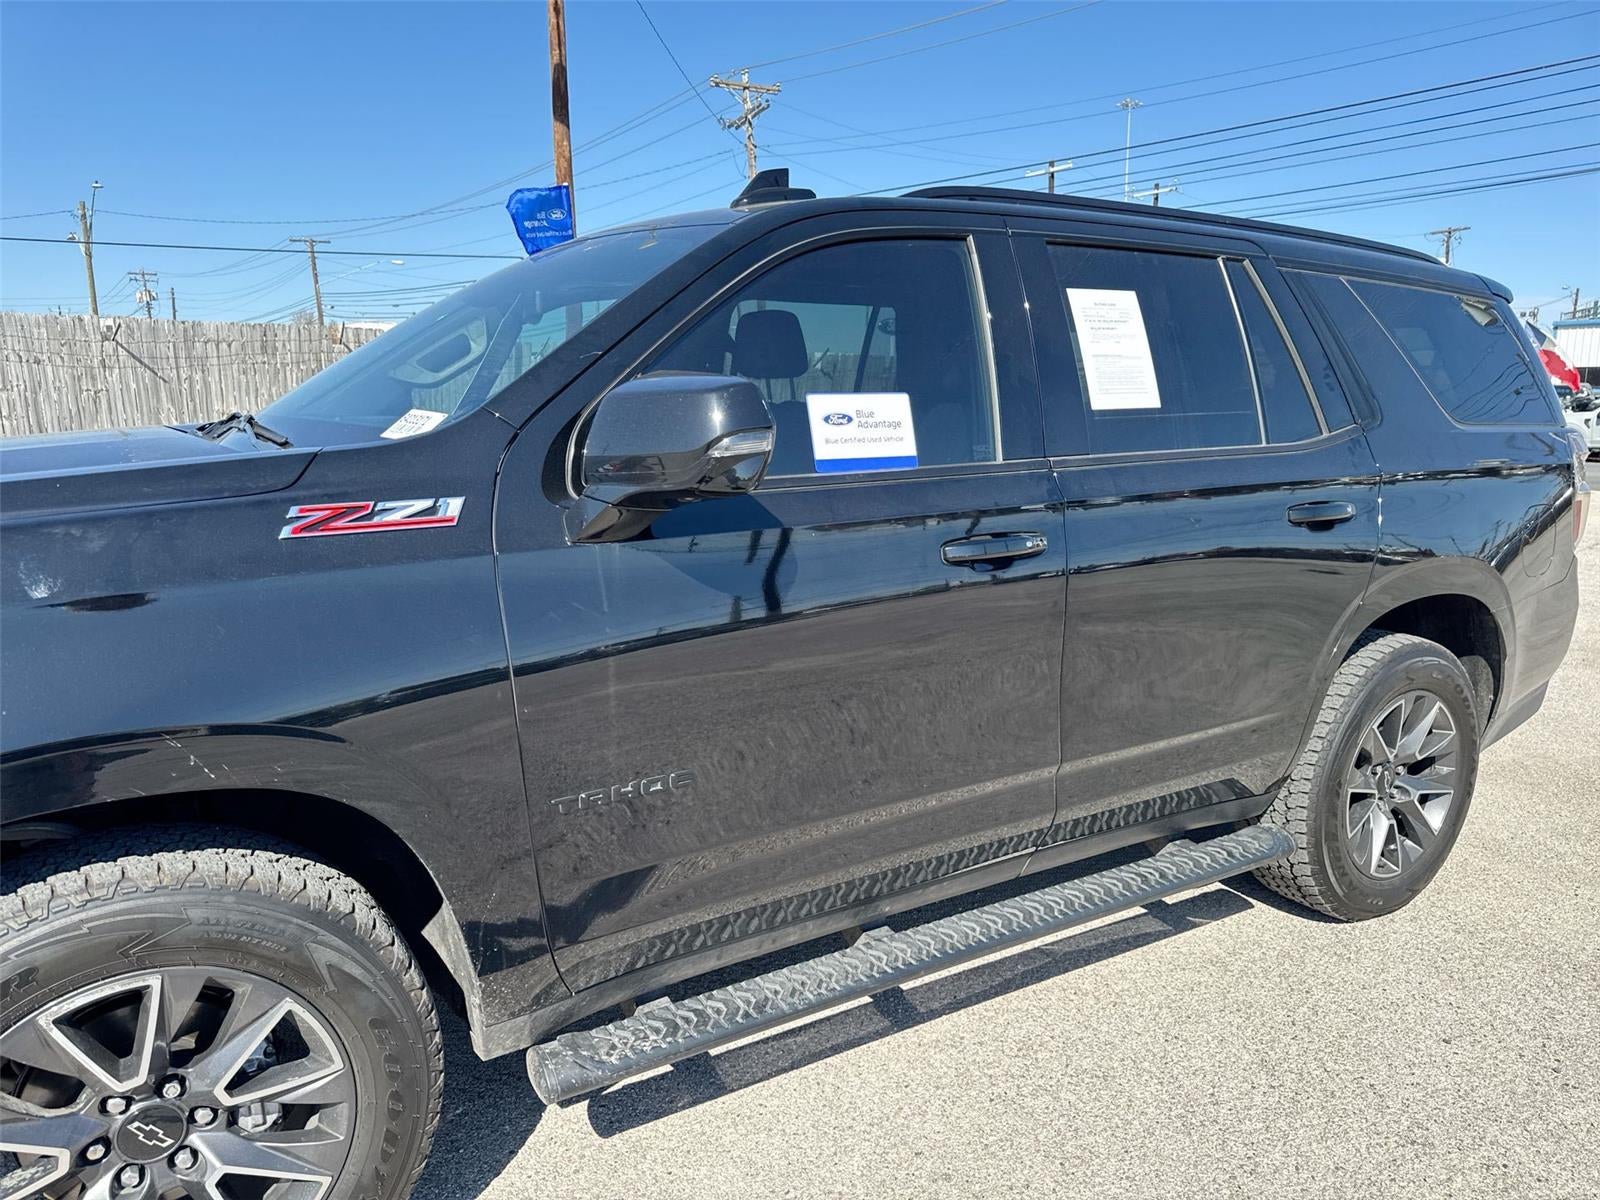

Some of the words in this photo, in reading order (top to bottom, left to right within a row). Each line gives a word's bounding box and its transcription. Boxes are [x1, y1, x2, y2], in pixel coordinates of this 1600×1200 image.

[855, 409, 875, 418] Blue
[827, 414, 849, 425] Ford
[857, 420, 902, 429] Advantage
[840, 436, 865, 444] Certified
[278, 495, 466, 539] Z71
[551, 769, 695, 814] TAHOE
